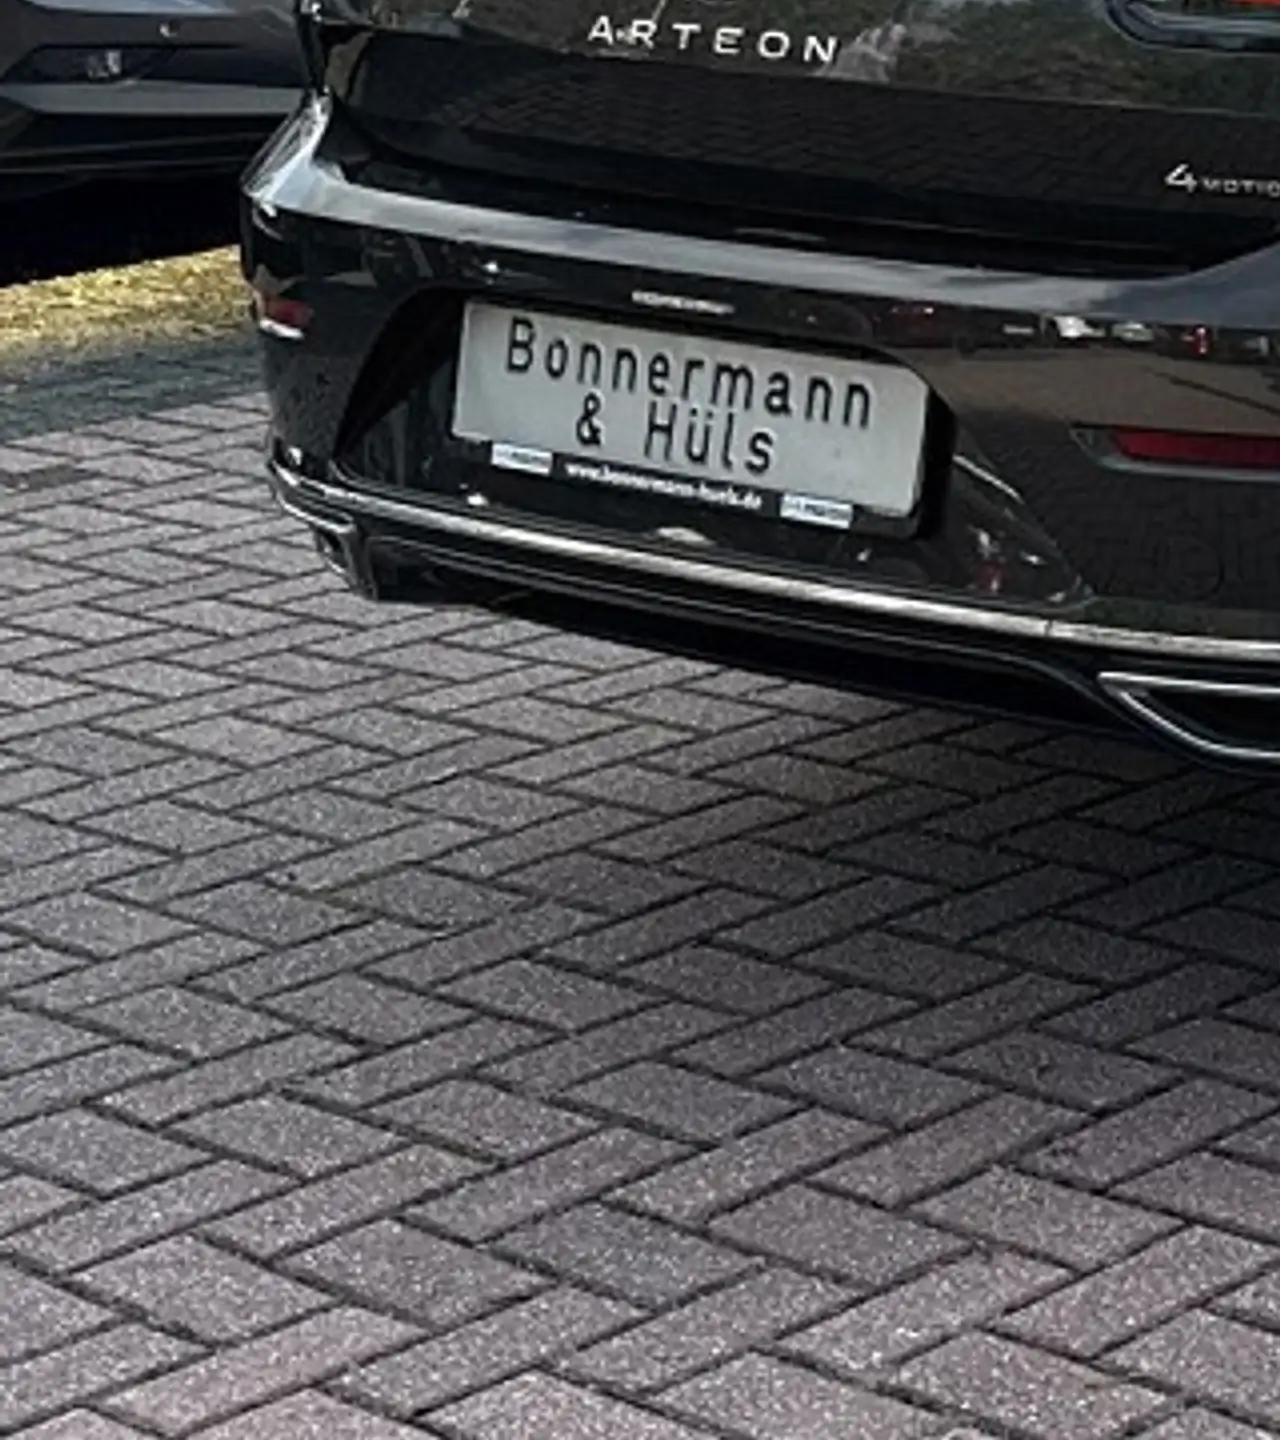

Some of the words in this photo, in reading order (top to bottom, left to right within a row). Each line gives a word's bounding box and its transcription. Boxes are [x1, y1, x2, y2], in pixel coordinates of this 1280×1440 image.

[587, 15, 838, 62] ARTEON
[505, 316, 873, 429] Bonnermann
[575, 392, 603, 448] &
[644, 400, 775, 474] Hüls
